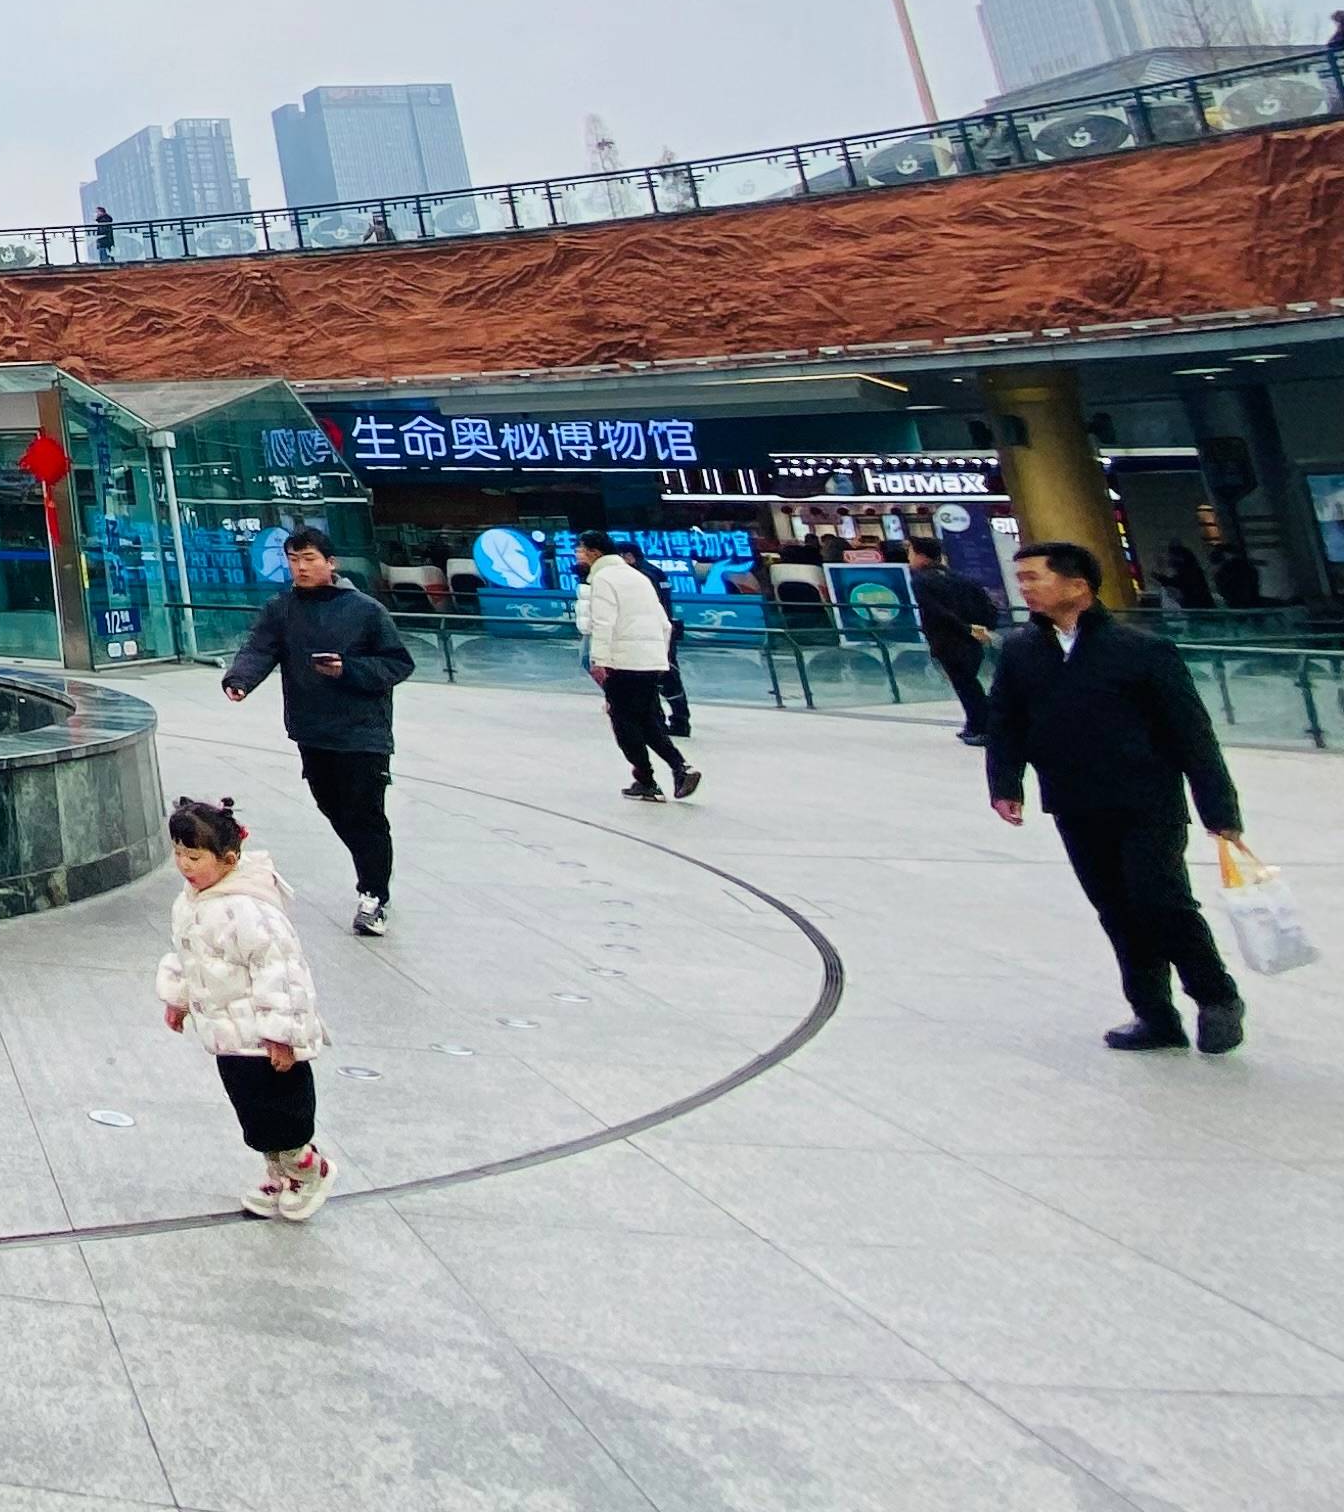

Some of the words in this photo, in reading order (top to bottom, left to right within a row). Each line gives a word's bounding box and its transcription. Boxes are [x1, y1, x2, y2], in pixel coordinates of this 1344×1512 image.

[352, 415, 698, 462] 生命奥秘博物馆
[553, 529, 753, 558] 生秘博物馆
